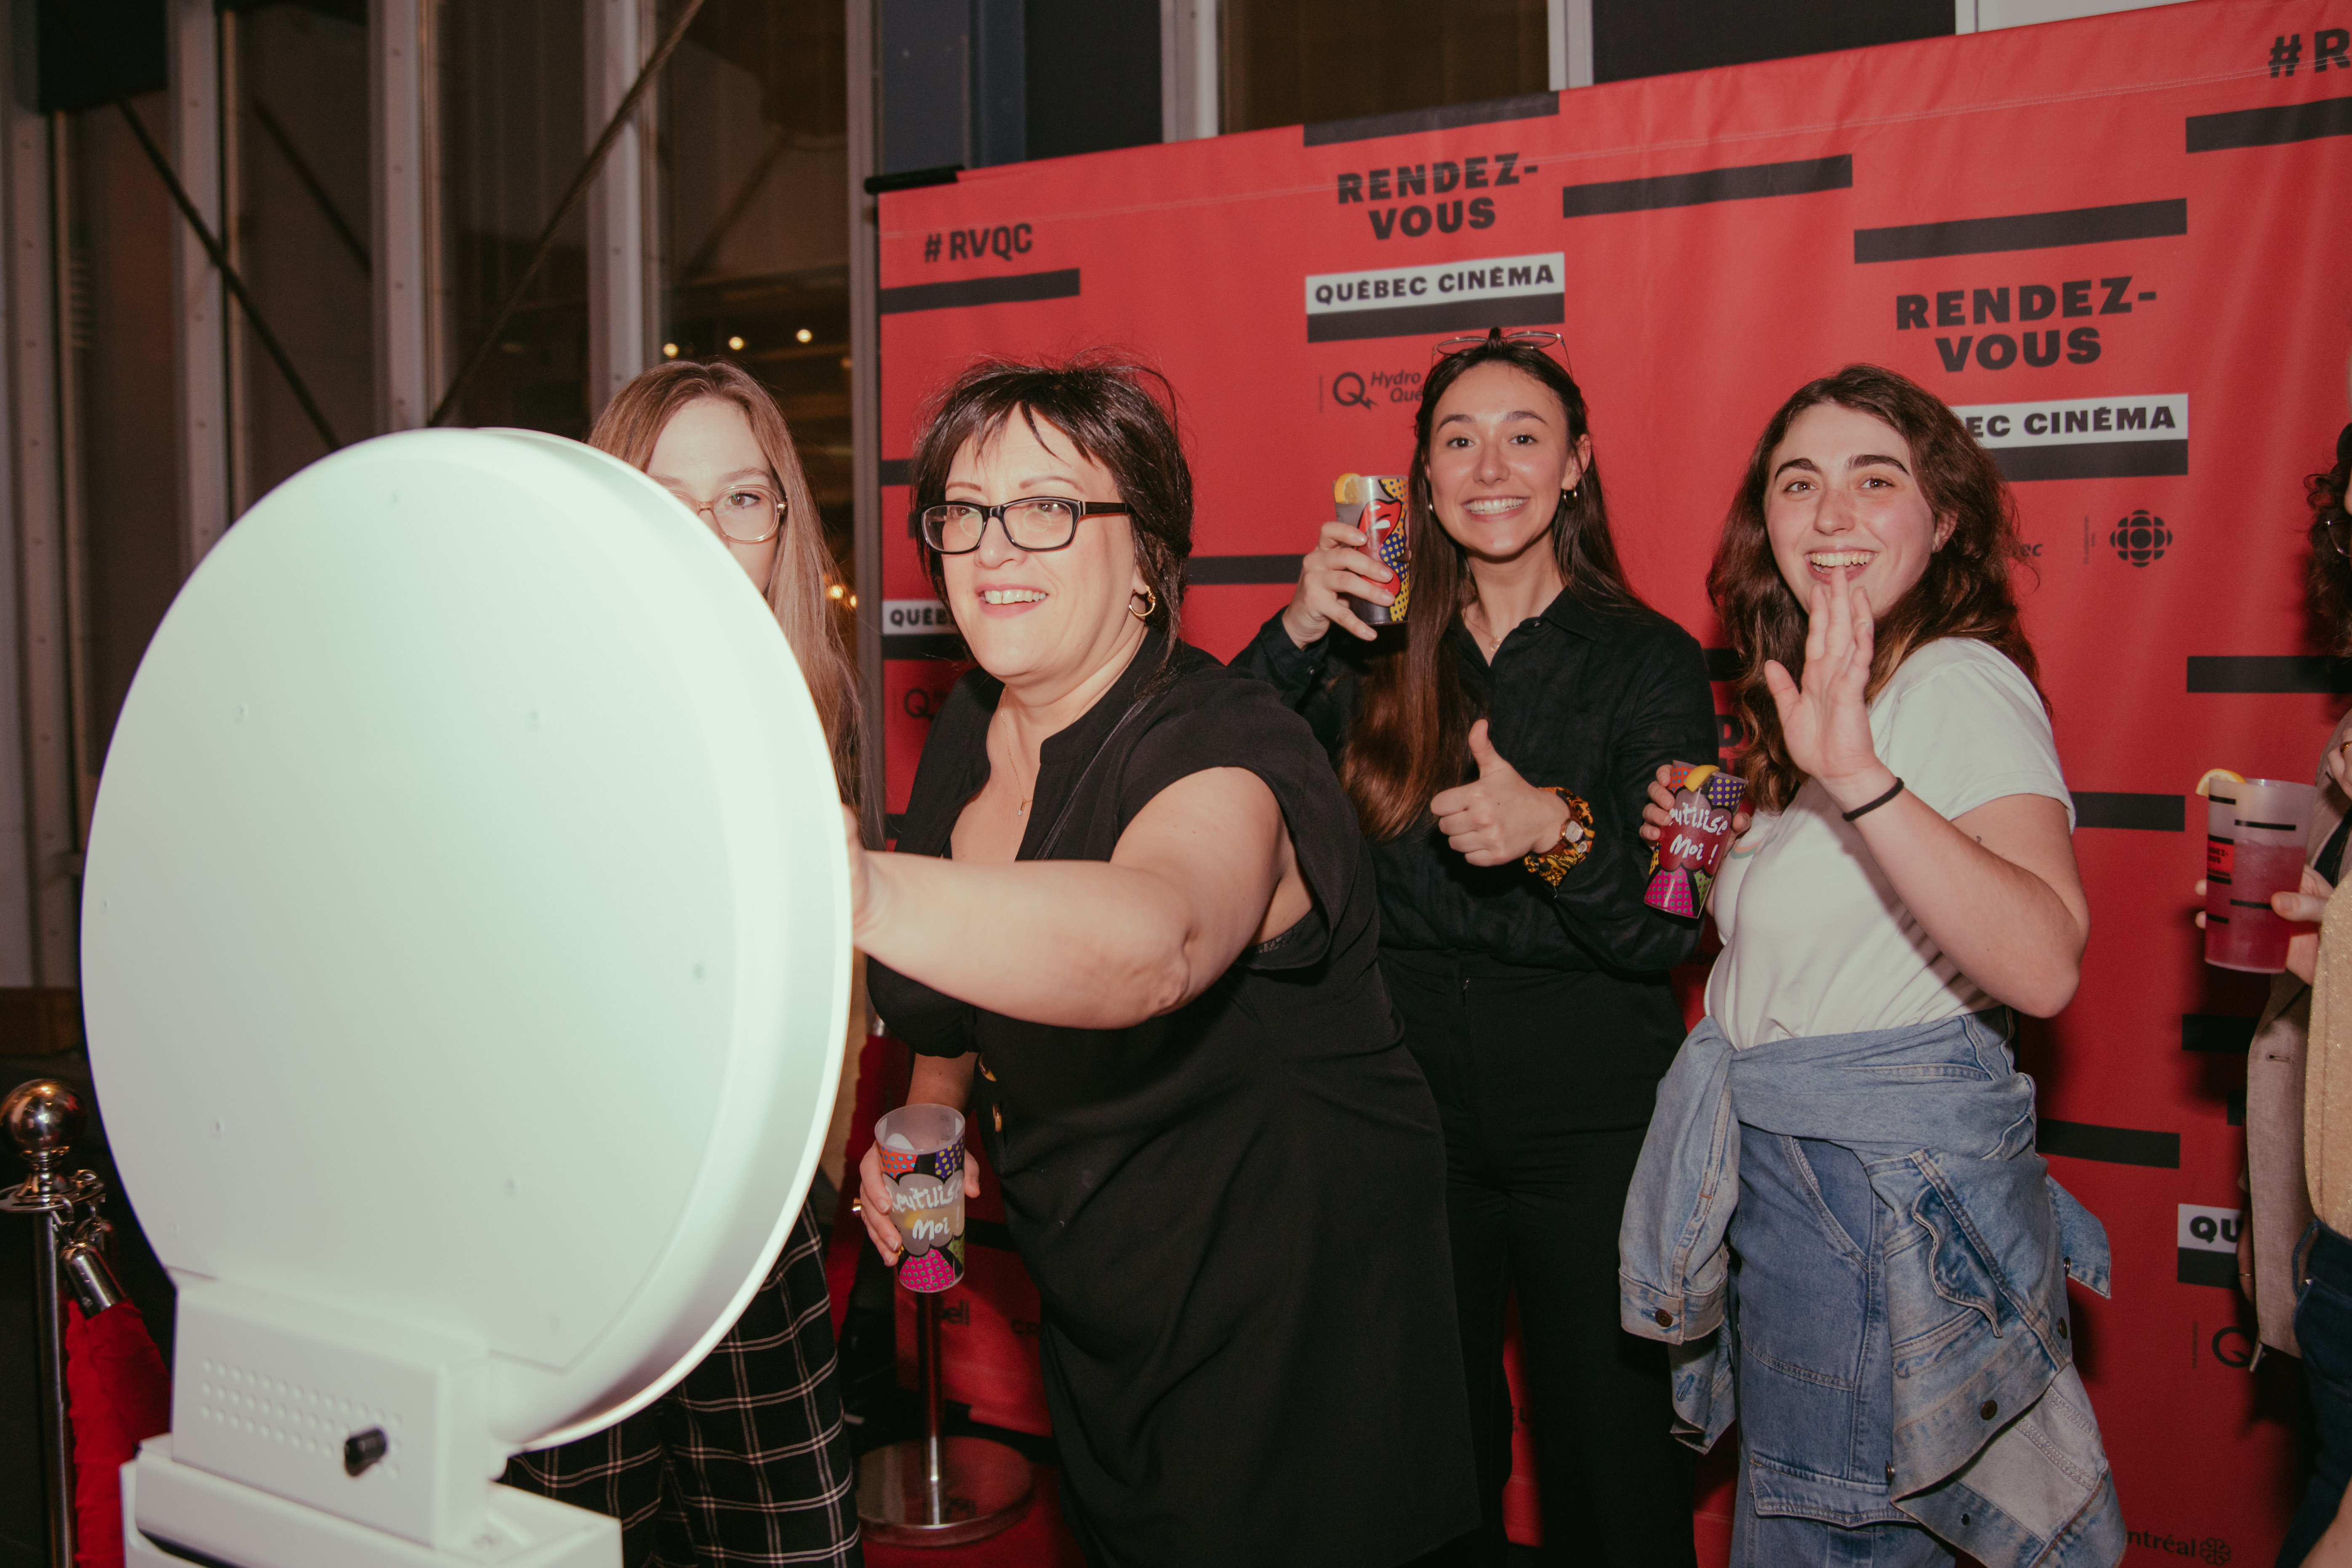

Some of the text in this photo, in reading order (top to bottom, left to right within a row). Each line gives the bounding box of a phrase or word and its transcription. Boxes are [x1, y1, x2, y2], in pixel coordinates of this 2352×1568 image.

[2268, 28, 2350, 78] #R
[1337, 152, 1539, 205] RENDEZ-
[1368, 197, 1496, 240] VOUS
[924, 222, 1033, 263] #RVQC
[1315, 264, 1555, 306] QUÉBEC CINÉMA
[1896, 276, 2157, 331] RENDEZ-
[1934, 327, 2101, 373] VOUS
[1371, 369, 1421, 388] Hydro
[1390, 385, 1423, 403] Qué
[1965, 405, 2176, 438] EC CINÉMA
[1669, 834, 1704, 861] Moi
[912, 1217, 950, 1241] Moi
[2189, 1216, 2244, 1243] QU
[2128, 1530, 2196, 1557] ntréal
